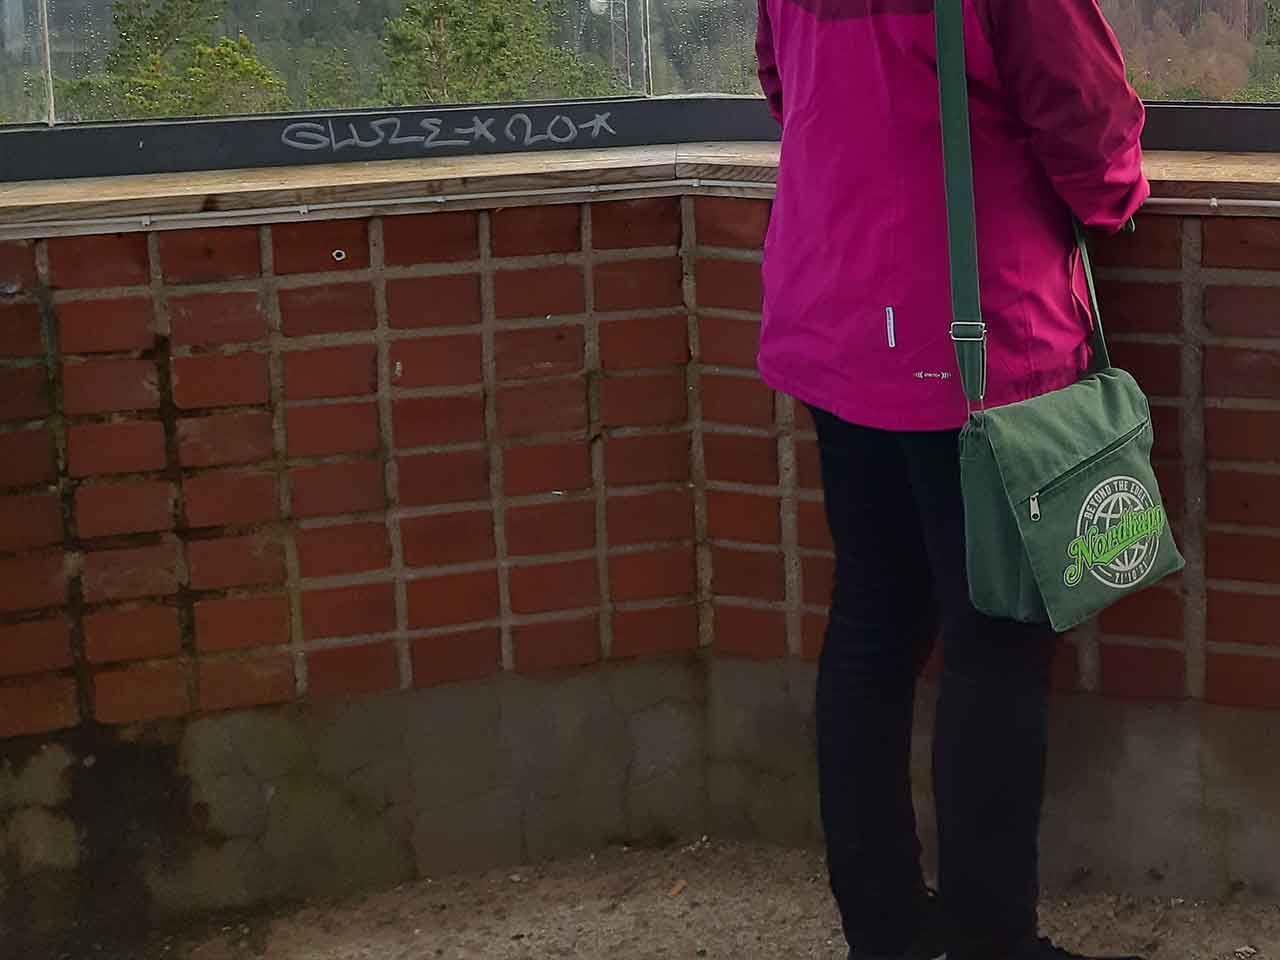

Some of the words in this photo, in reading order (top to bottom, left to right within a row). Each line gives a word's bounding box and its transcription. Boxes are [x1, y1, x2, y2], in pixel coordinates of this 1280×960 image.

[1084, 486, 1113, 520] BEYOND
[1113, 480, 1129, 491] THE
[1131, 483, 1147, 503] EDGE
